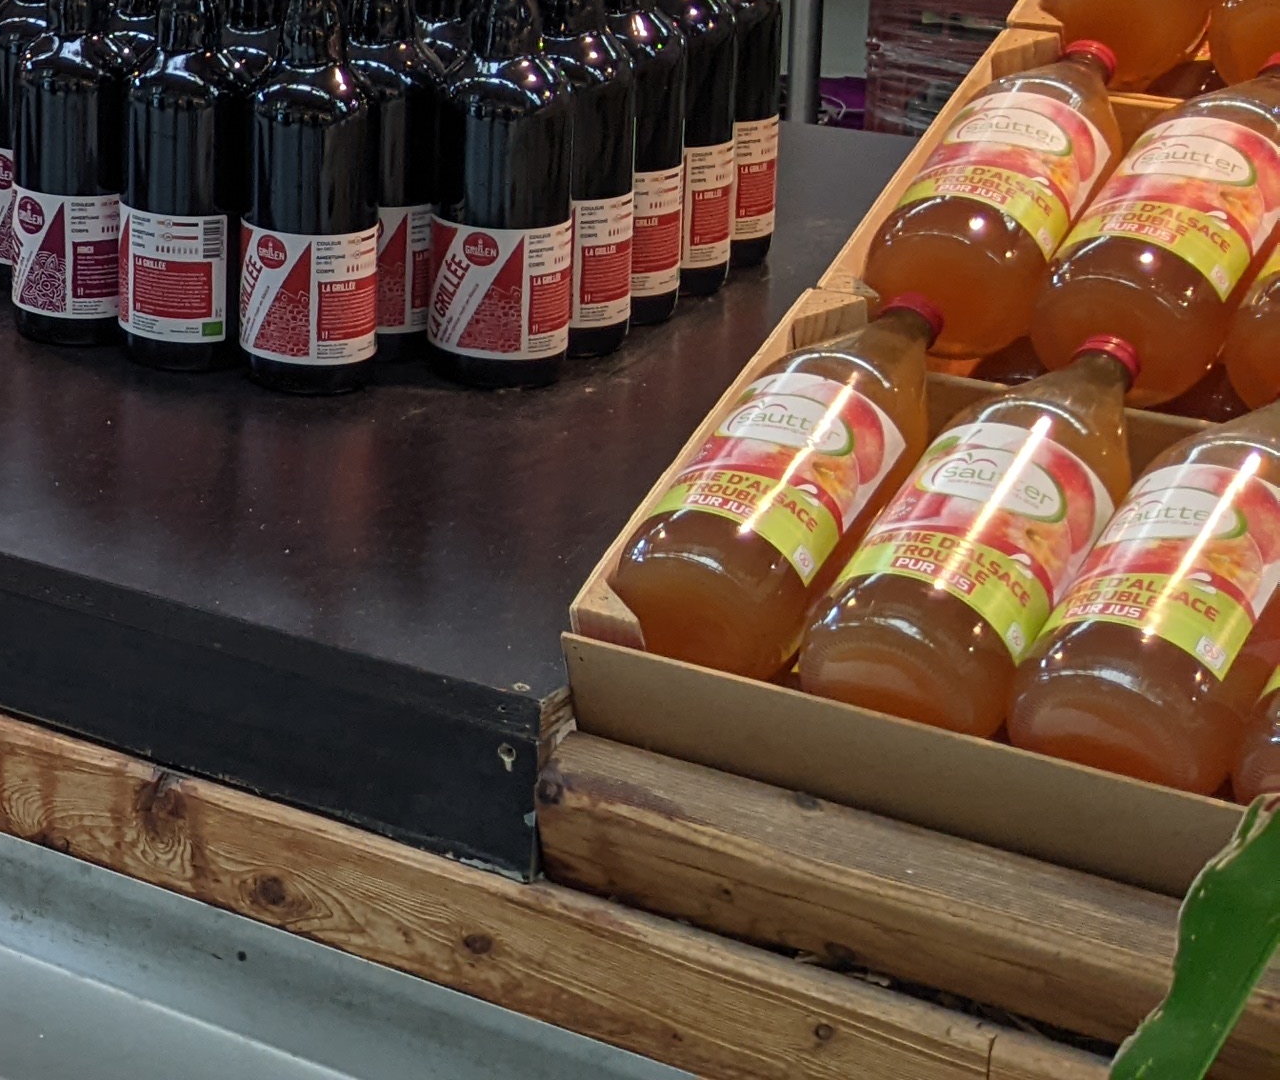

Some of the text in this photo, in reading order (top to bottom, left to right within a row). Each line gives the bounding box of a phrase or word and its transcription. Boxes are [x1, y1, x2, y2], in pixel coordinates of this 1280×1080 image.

[965, 120, 1062, 145] sautter
[740, 165, 749, 174] LA
[1141, 150, 1243, 173] sautter
[695, 191, 703, 200] LA
[933, 176, 1018, 200] TROUBLE
[937, 184, 1004, 203] PUR JUS
[971, 166, 1054, 218] D'ALSACE
[528, 232, 552, 240] COULEUR
[1103, 222, 1172, 241] PUR JUS
[1140, 202, 1231, 254] D'ALSACE
[258, 241, 286, 261] GRILLEN
[465, 238, 498, 258] GRILLEN
[528, 246, 555, 254] AMERTUME
[585, 247, 594, 257] LA
[135, 256, 142, 267] LA
[321, 280, 358, 293] LA GRILLÉE
[532, 277, 542, 286] LA
[428, 253, 472, 339] LA GRILLÉE
[736, 411, 841, 441] sauttr
[686, 494, 723, 507] PUR
[895, 557, 972, 592] PUR US
[1106, 575, 1220, 622] D'ALACE
[1065, 603, 1143, 619] PUR JUS
